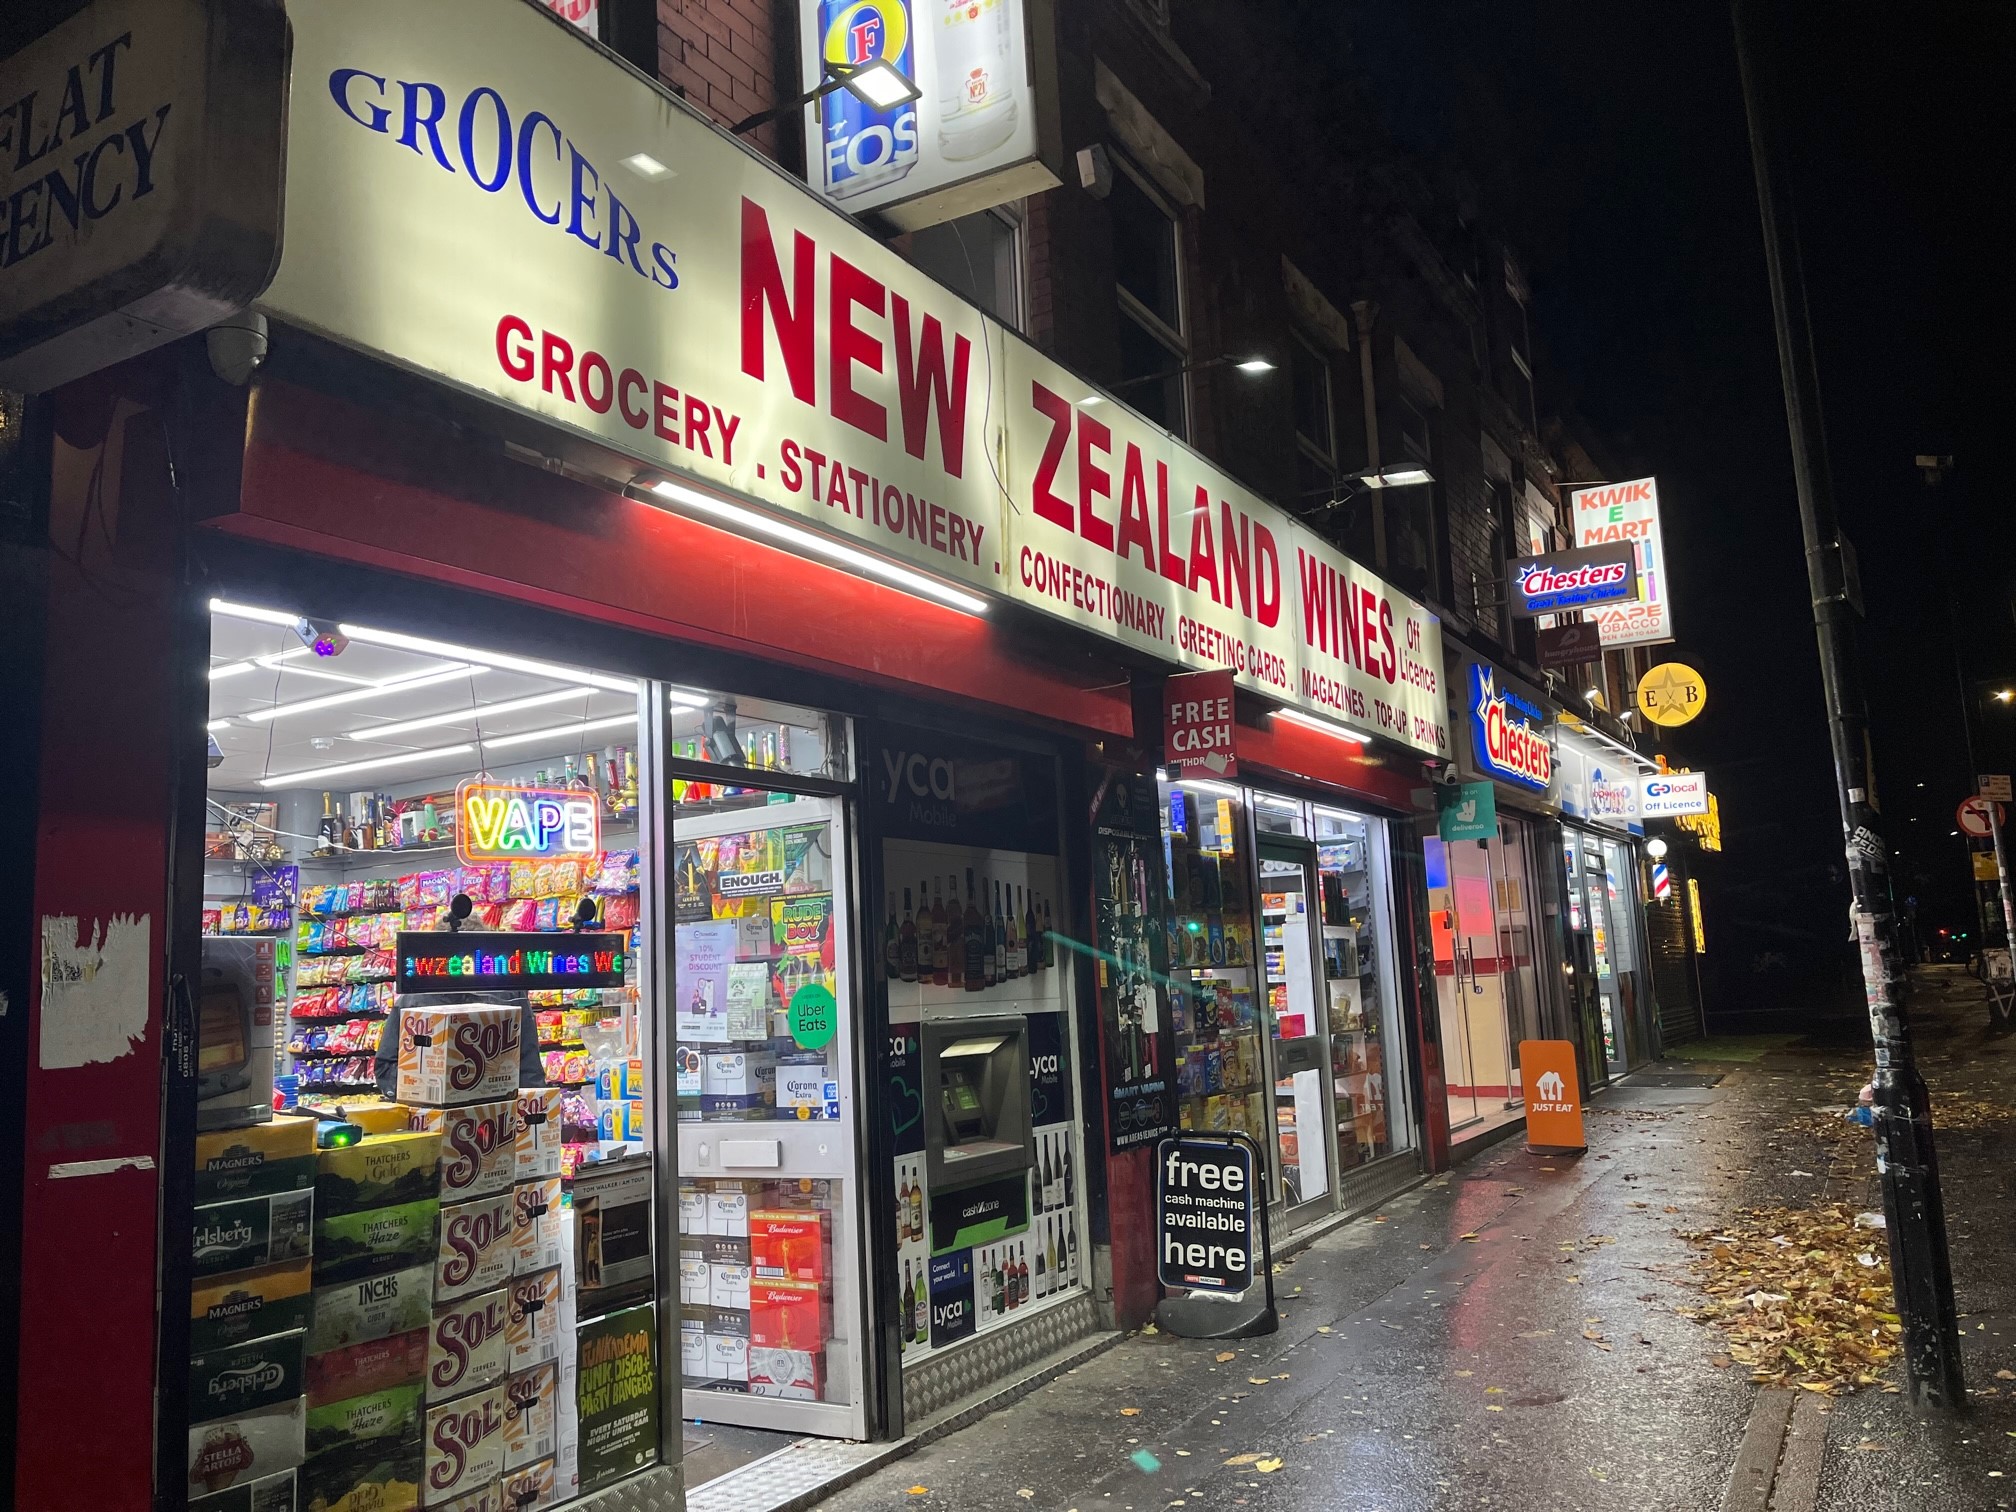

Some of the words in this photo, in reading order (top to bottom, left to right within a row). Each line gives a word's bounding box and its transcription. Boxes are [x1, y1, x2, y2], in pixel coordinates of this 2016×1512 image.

[0, 103, 171, 269] ENCY
[328, 68, 679, 290] GROCERS
[741, 195, 971, 480] NEW
[1032, 380, 1281, 628] ZEALAND
[1298, 546, 1395, 685] WINES
[1579, 482, 1651, 511] KWIK
[1608, 505, 1624, 523] E
[496, 314, 740, 466] GROCERY
[780, 438, 984, 566] STATIONERY
[1020, 545, 1165, 642] CONFECTIONARY
[1178, 614, 1244, 673] GREETING
[1248, 643, 1287, 690] CARDS
[1302, 667, 1364, 718] MAGAZINES
[1374, 699, 1407, 735] TOP-UP
[1414, 716, 1446, 750] DRINKS
[1584, 518, 1654, 545] MART
[1523, 564, 1625, 594] Chesters
[1589, 604, 1662, 624] VAPE
[1407, 617, 1421, 653] Off
[1597, 617, 1660, 634] OBACCO
[1544, 644, 1599, 658] hungryhouse
[1399, 647, 1436, 694] Licence
[1644, 690, 1658, 707] E
[1685, 686, 1699, 703] B
[1171, 698, 1230, 725] FREE
[1172, 725, 1231, 752] CASH
[1486, 704, 1549, 780] Chesters
[1171, 753, 1235, 768] THDRLS
[881, 748, 956, 803] yca
[908, 801, 957, 827] Mobile
[1645, 802, 1661, 811] Off
[1663, 800, 1702, 810] Licence
[467, 795, 596, 852] VAPE
[1098, 826, 1135, 839] DISPOSABLE
[1452, 822, 1485, 832] deliveroo
[721, 873, 782, 888] ENOUGH.
[783, 904, 822, 923] RUDE
[787, 923, 819, 939] BOY
[527, 950, 590, 975] Wines
[688, 963, 722, 971] DISCOUNT
[690, 953, 721, 962] STUDENT
[797, 1004, 826, 1017] Uber
[799, 1019, 827, 1032] Eats
[450, 1018, 519, 1091] SOL
[488, 1075, 511, 1083] CERVEZA
[754, 1066, 776, 1078] Coron
[787, 1080, 818, 1093] Corona
[1532, 1103, 1554, 1112] JUST
[1556, 1103, 1573, 1112] EAT
[365, 1151, 411, 1166] THATCHERS
[446, 1111, 515, 1188] SOL
[208, 1155, 263, 1172] MAGNERS
[1166, 1151, 1245, 1192] free
[484, 1169, 508, 1179] CERVEZA
[583, 1185, 595, 1193] TOM
[596, 1181, 618, 1190] WALKER
[631, 1176, 645, 1184] TOUR
[1165, 1193, 1193, 1205] cash
[1195, 1196, 1245, 1210] machine
[363, 1216, 408, 1233] THATCHERS
[767, 1223, 804, 1233] Budweiser
[1165, 1211, 1245, 1233] available
[193, 1220, 252, 1246] rlsberg
[368, 1230, 400, 1246] Haze
[443, 1204, 512, 1286] SOL
[1165, 1232, 1246, 1272] here
[480, 1263, 504, 1275] CERVEZA
[932, 1261, 951, 1273] Connect
[933, 1275, 943, 1286] your
[943, 1271, 956, 1281] world
[766, 1291, 803, 1302] Budweiser
[209, 1298, 261, 1320] MAGNERS
[934, 1299, 963, 1326] Lyca
[432, 1300, 504, 1388] SOL
[581, 1329, 650, 1369] FUNKADEMIA
[354, 1350, 390, 1367] THATCHERS
[473, 1361, 497, 1373] CERVEZA
[209, 1363, 284, 1397] Carlsberg
[580, 1382, 610, 1419] PARTY
[613, 1371, 653, 1406] BANGERS
[345, 1398, 392, 1420] THATCHERS
[351, 1415, 383, 1432] Haze
[586, 1432, 610, 1447] NIGHT
[612, 1423, 632, 1437] UNTIL
[634, 1415, 649, 1427] 4AM
[590, 1422, 612, 1438] EVERY
[613, 1408, 648, 1428] SATURDAY
[430, 1397, 501, 1490] SOL
[203, 1446, 241, 1464] STELLA
[203, 1456, 241, 1473] ARTOIS
[470, 1460, 494, 1473] CERVEZA
